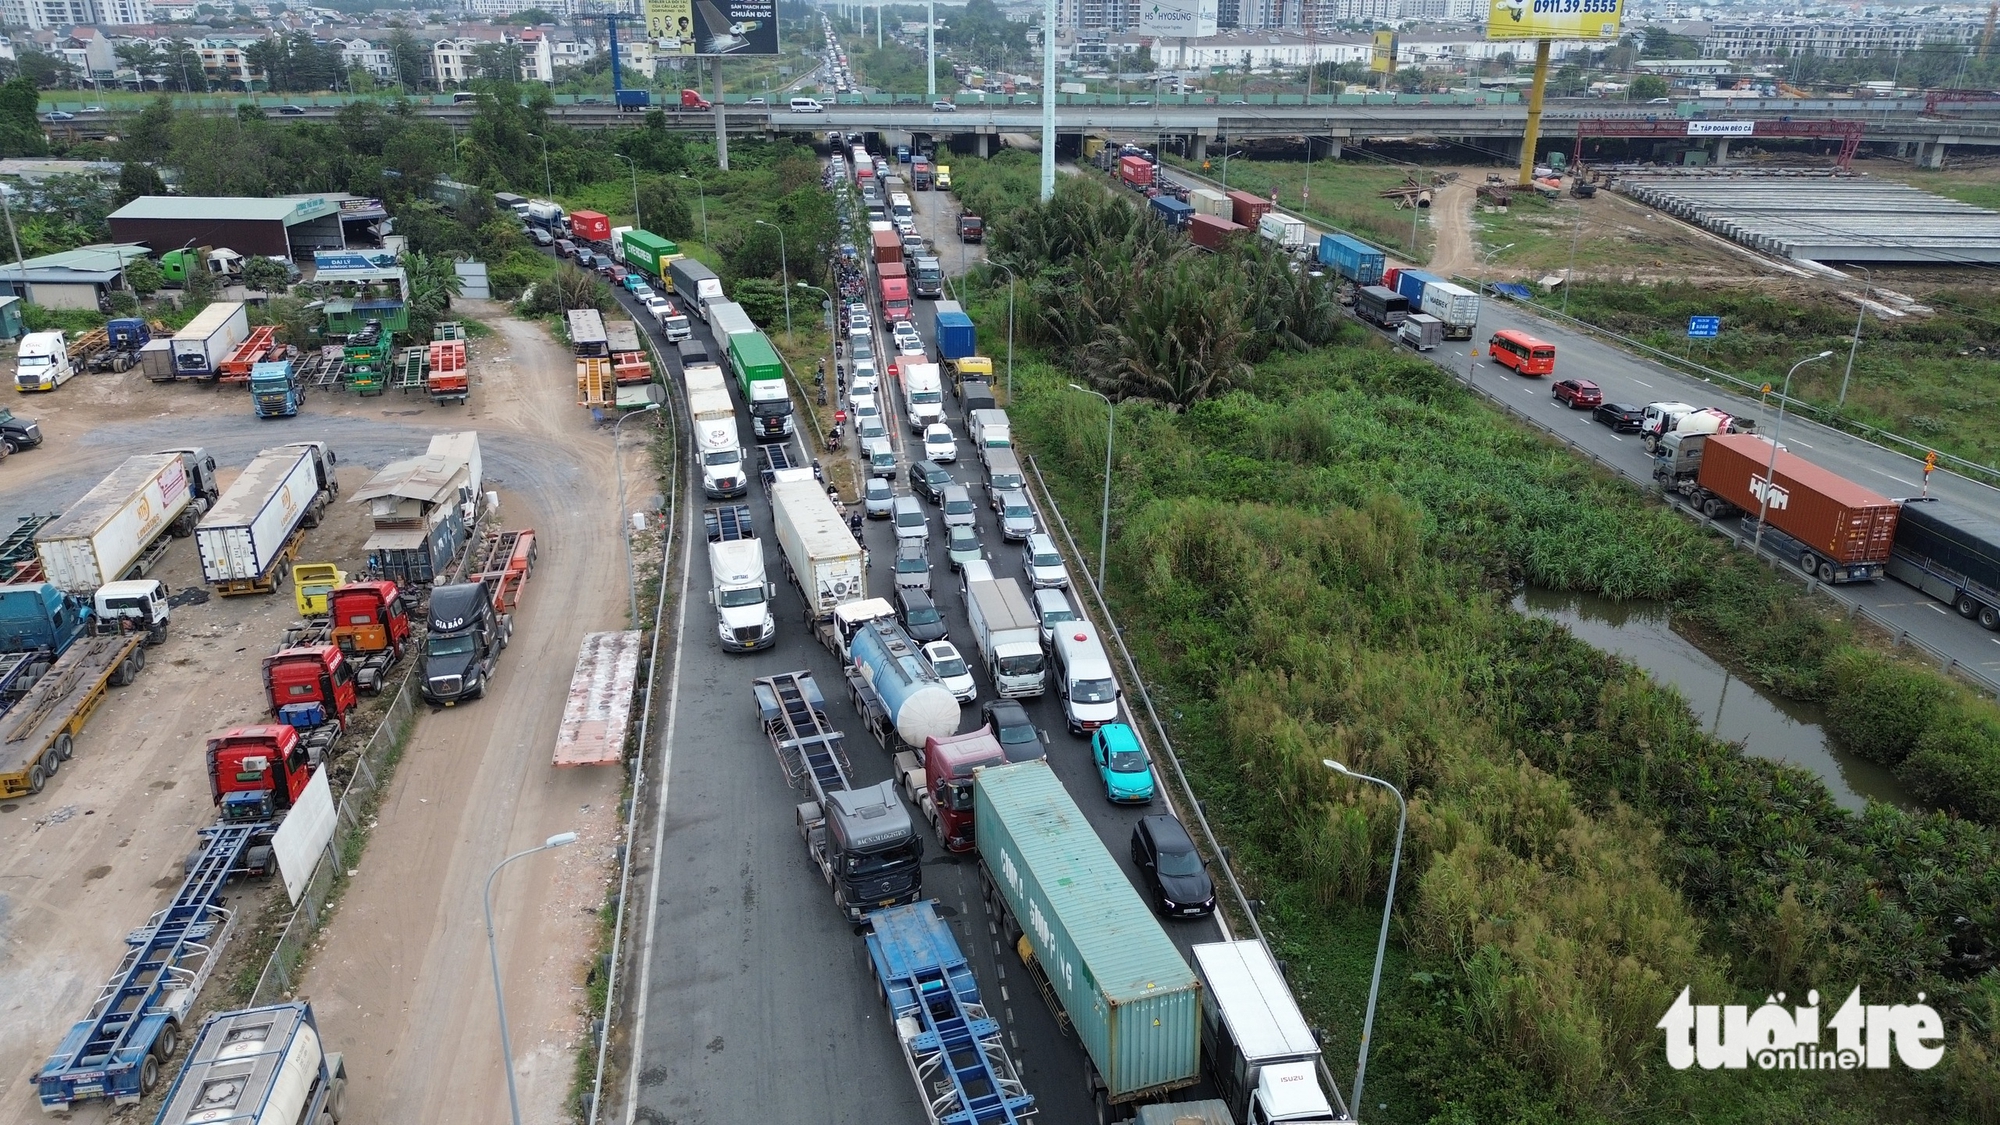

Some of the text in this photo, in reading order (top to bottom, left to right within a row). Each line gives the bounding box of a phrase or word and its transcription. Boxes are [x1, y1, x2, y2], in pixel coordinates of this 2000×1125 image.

[1533, 0, 1617, 13] 0911.39.5555
[1159, 12, 1191, 21] HYOSUNG
[435, 619, 447, 629] GIA
[1280, 1075, 1304, 1083] ISUZU
